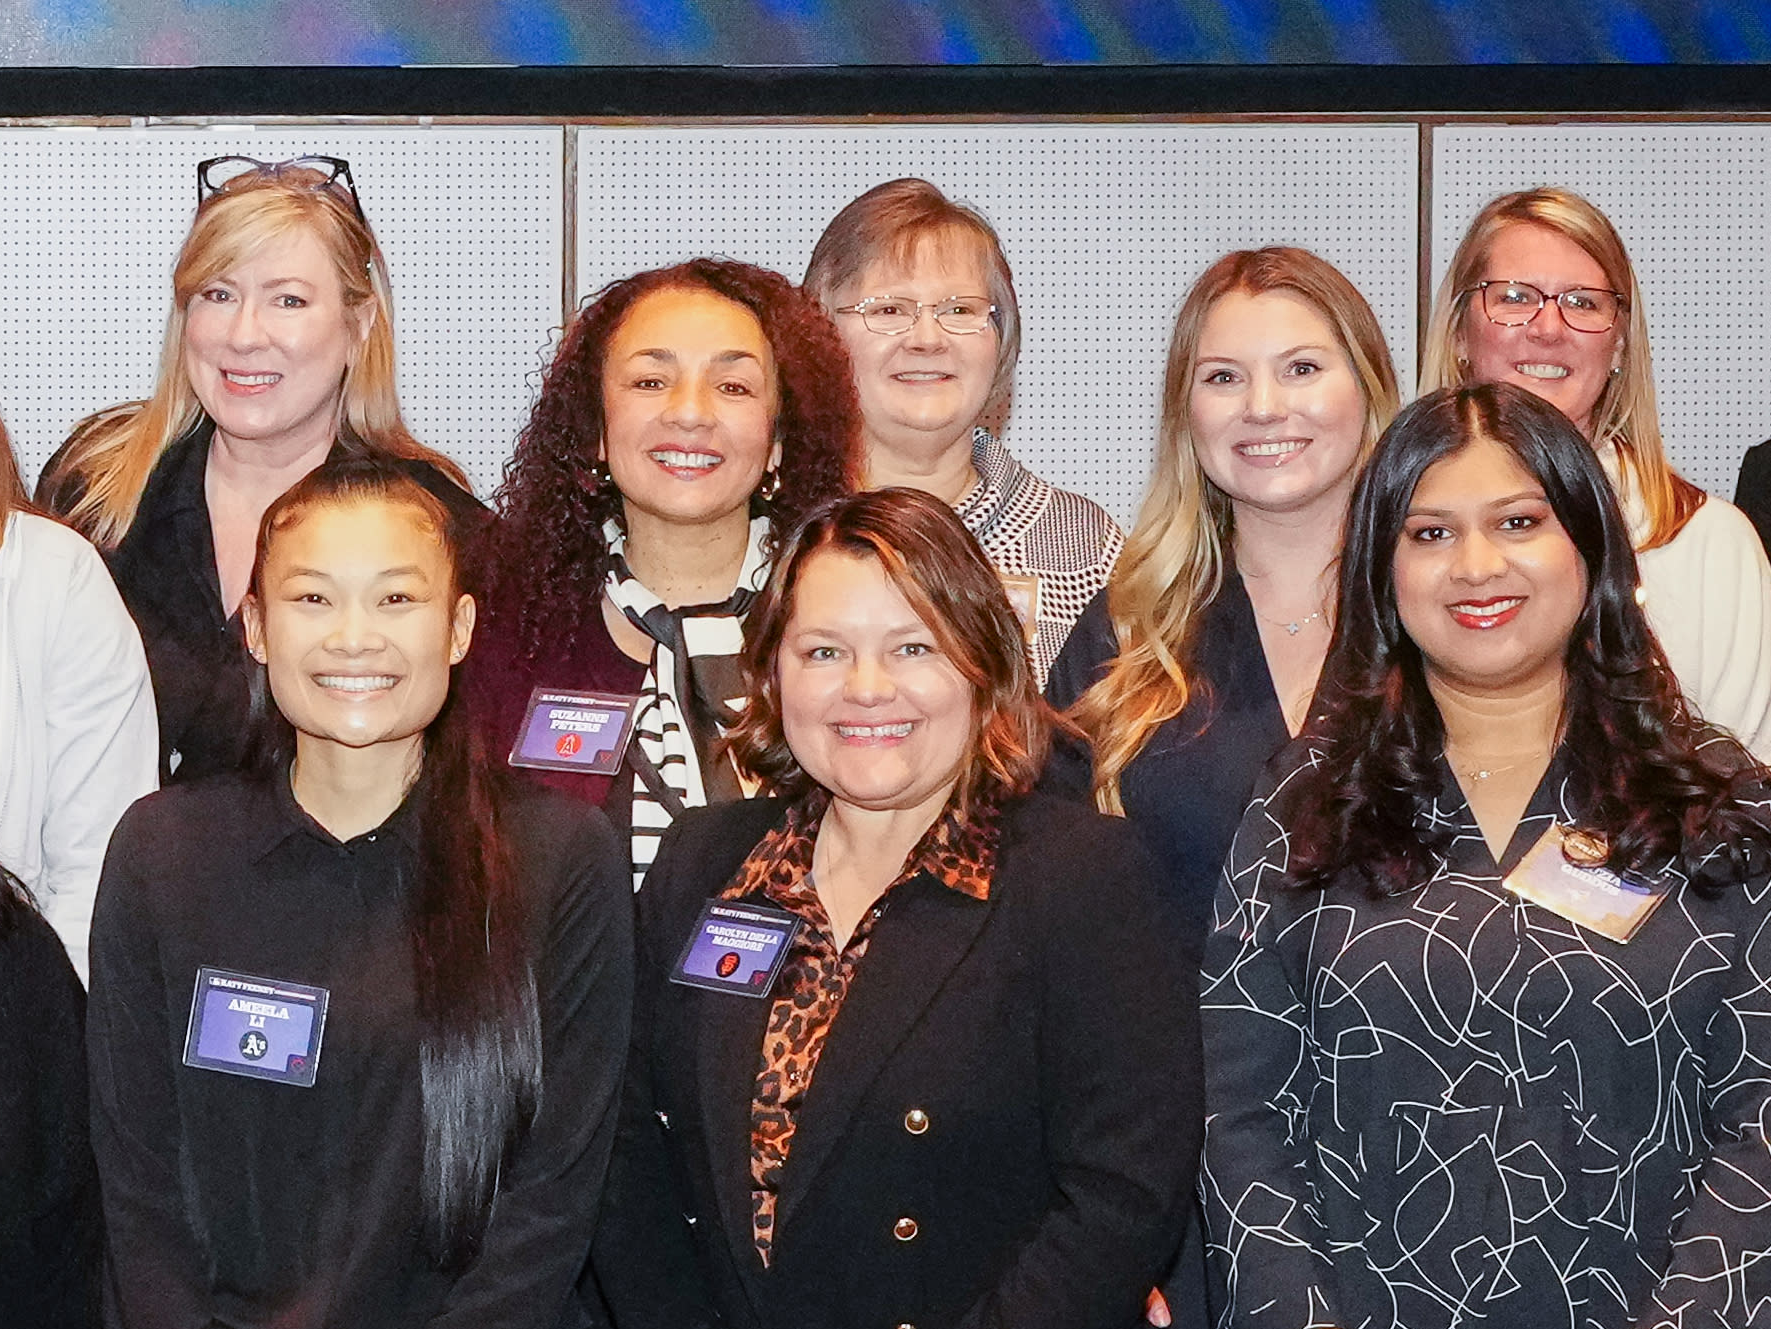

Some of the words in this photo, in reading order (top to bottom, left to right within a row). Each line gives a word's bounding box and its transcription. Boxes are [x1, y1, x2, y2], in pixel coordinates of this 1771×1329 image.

[549, 709, 610, 724] SUZANNE
[706, 925, 748, 939] CAROLYN
[749, 931, 778, 945] DELLA
[228, 998, 289, 1020] AMEELA
[248, 1014, 266, 1028] LI
